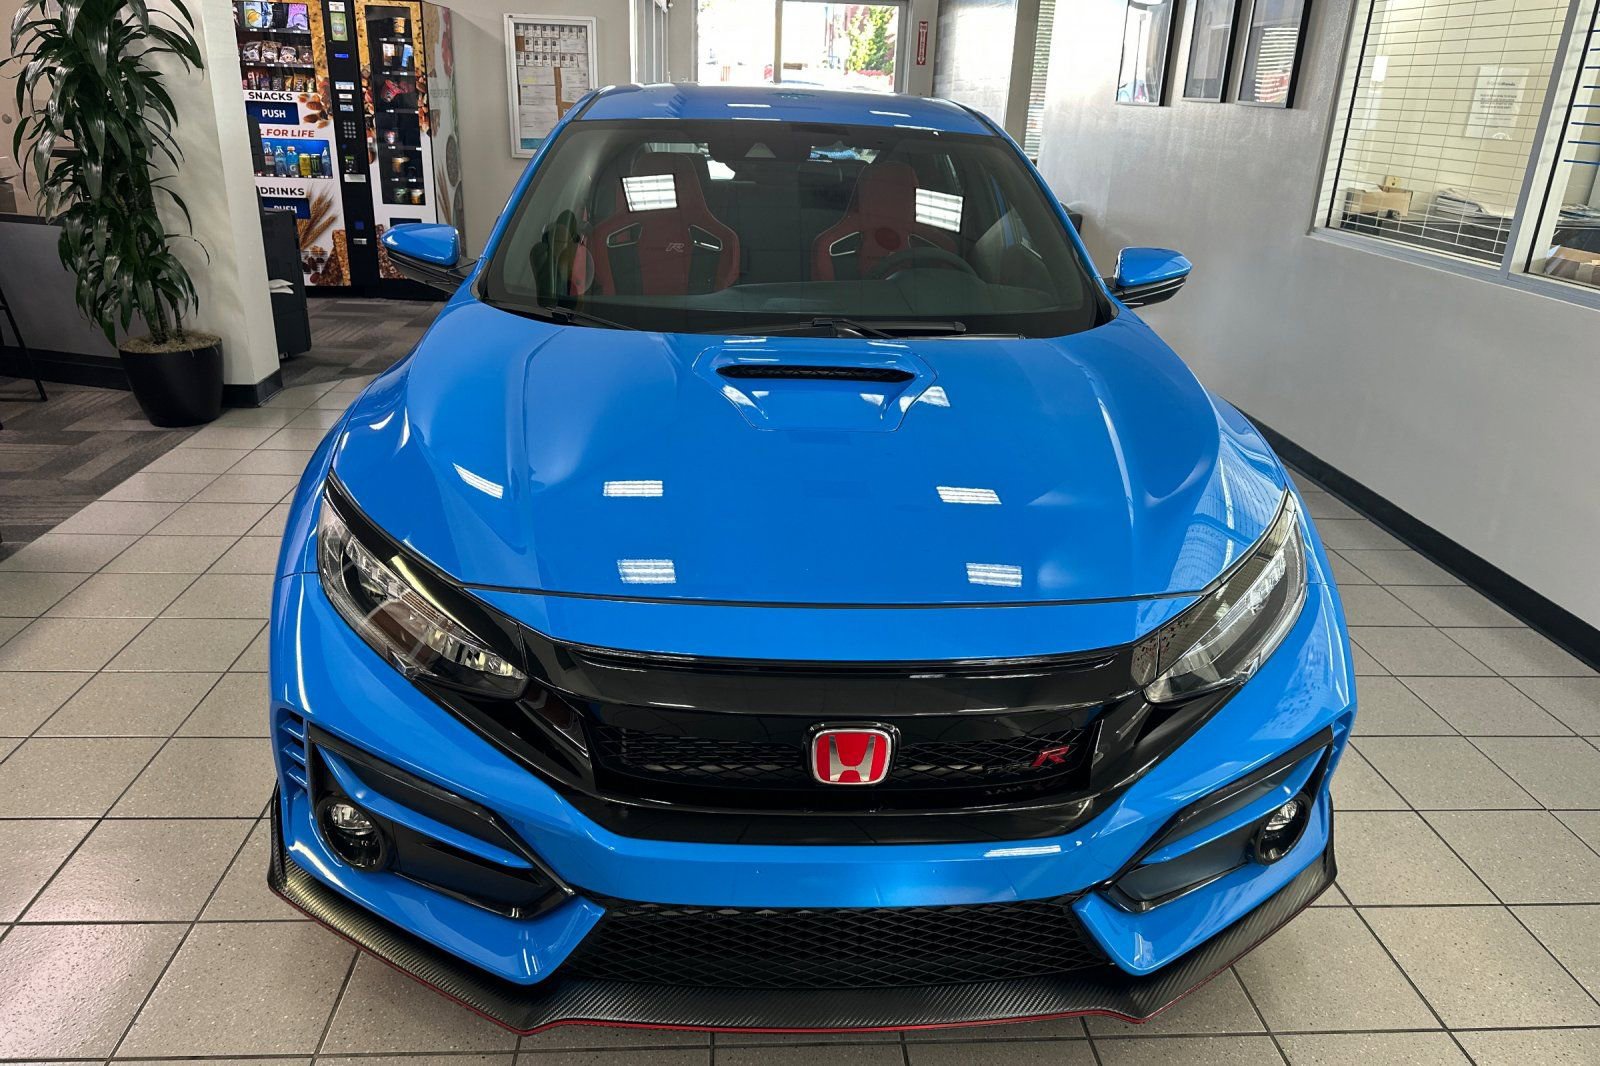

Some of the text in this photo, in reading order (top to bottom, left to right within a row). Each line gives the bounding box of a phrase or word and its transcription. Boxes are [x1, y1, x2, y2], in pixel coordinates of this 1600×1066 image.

[248, 91, 293, 101] SNACKS
[261, 108, 287, 118] PUSH
[266, 128, 288, 137] FOR
[291, 129, 315, 138] LIFE
[260, 186, 305, 196] DRINKS
[1029, 745, 1071, 768] R
